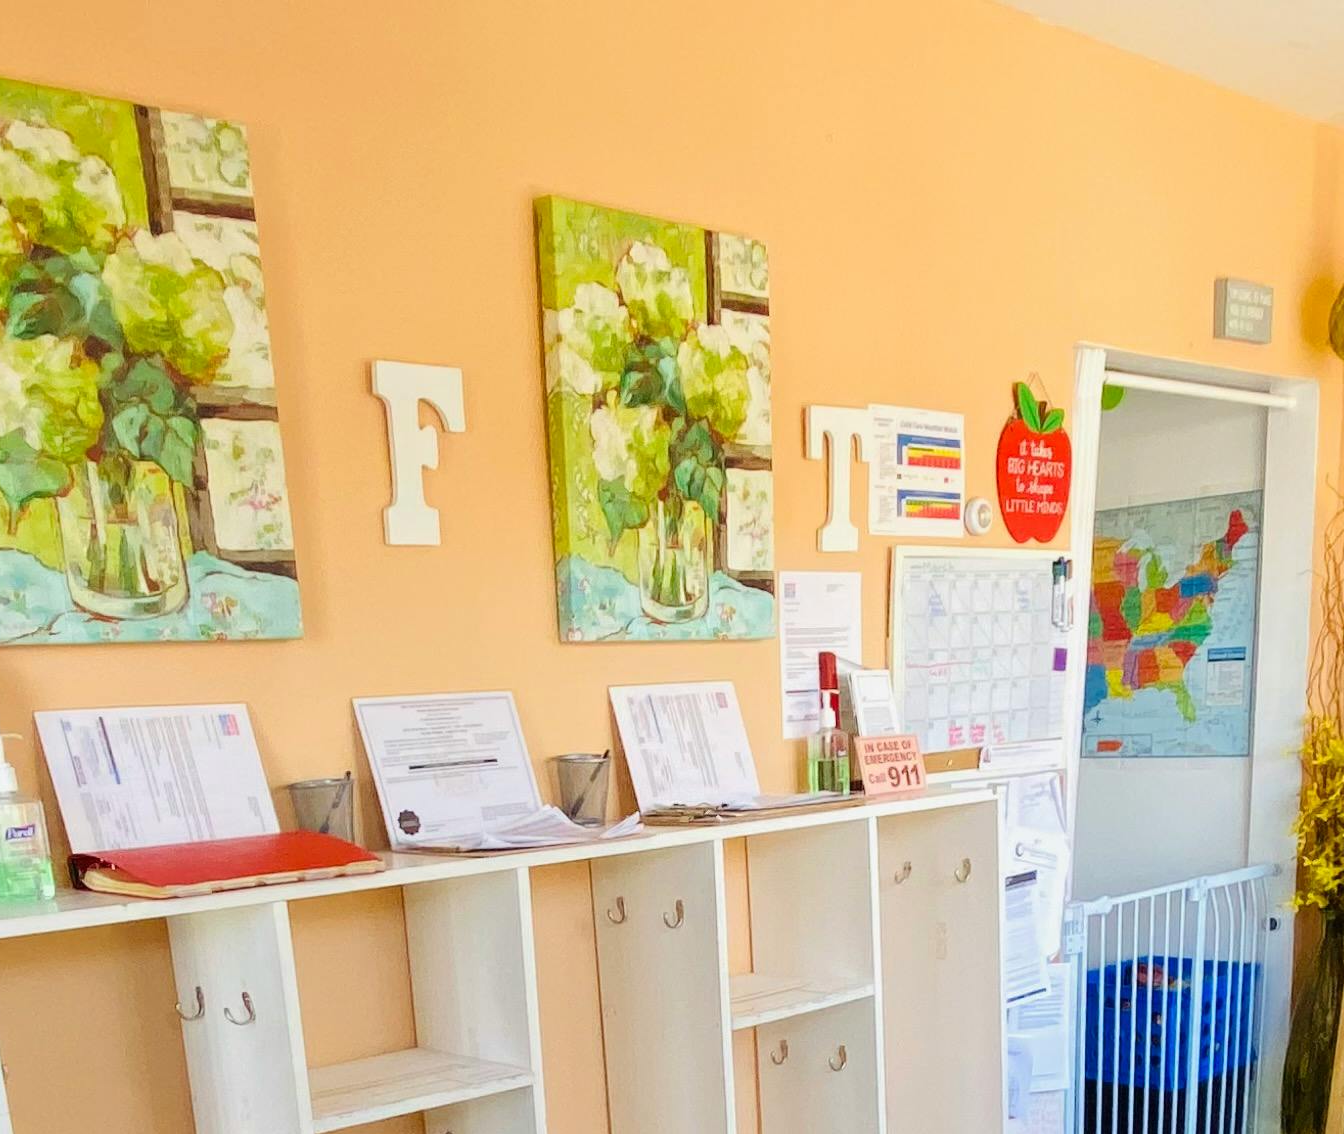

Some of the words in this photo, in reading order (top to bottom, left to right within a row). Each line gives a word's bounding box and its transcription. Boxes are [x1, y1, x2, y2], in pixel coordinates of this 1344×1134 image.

[371, 359, 465, 545] F
[806, 405, 869, 552] T
[1007, 457, 1025, 474] BIG
[1027, 460, 1065, 478] HEARTS
[1006, 499, 1034, 513] LITTLE
[1037, 501, 1064, 515] MINDS
[864, 743, 874, 753] IN
[876, 740, 899, 752] CASE
[901, 740, 911, 749] OF
[864, 751, 916, 765] EMERGENCY
[869, 772, 886, 784] Call
[888, 764, 920, 787] 911
